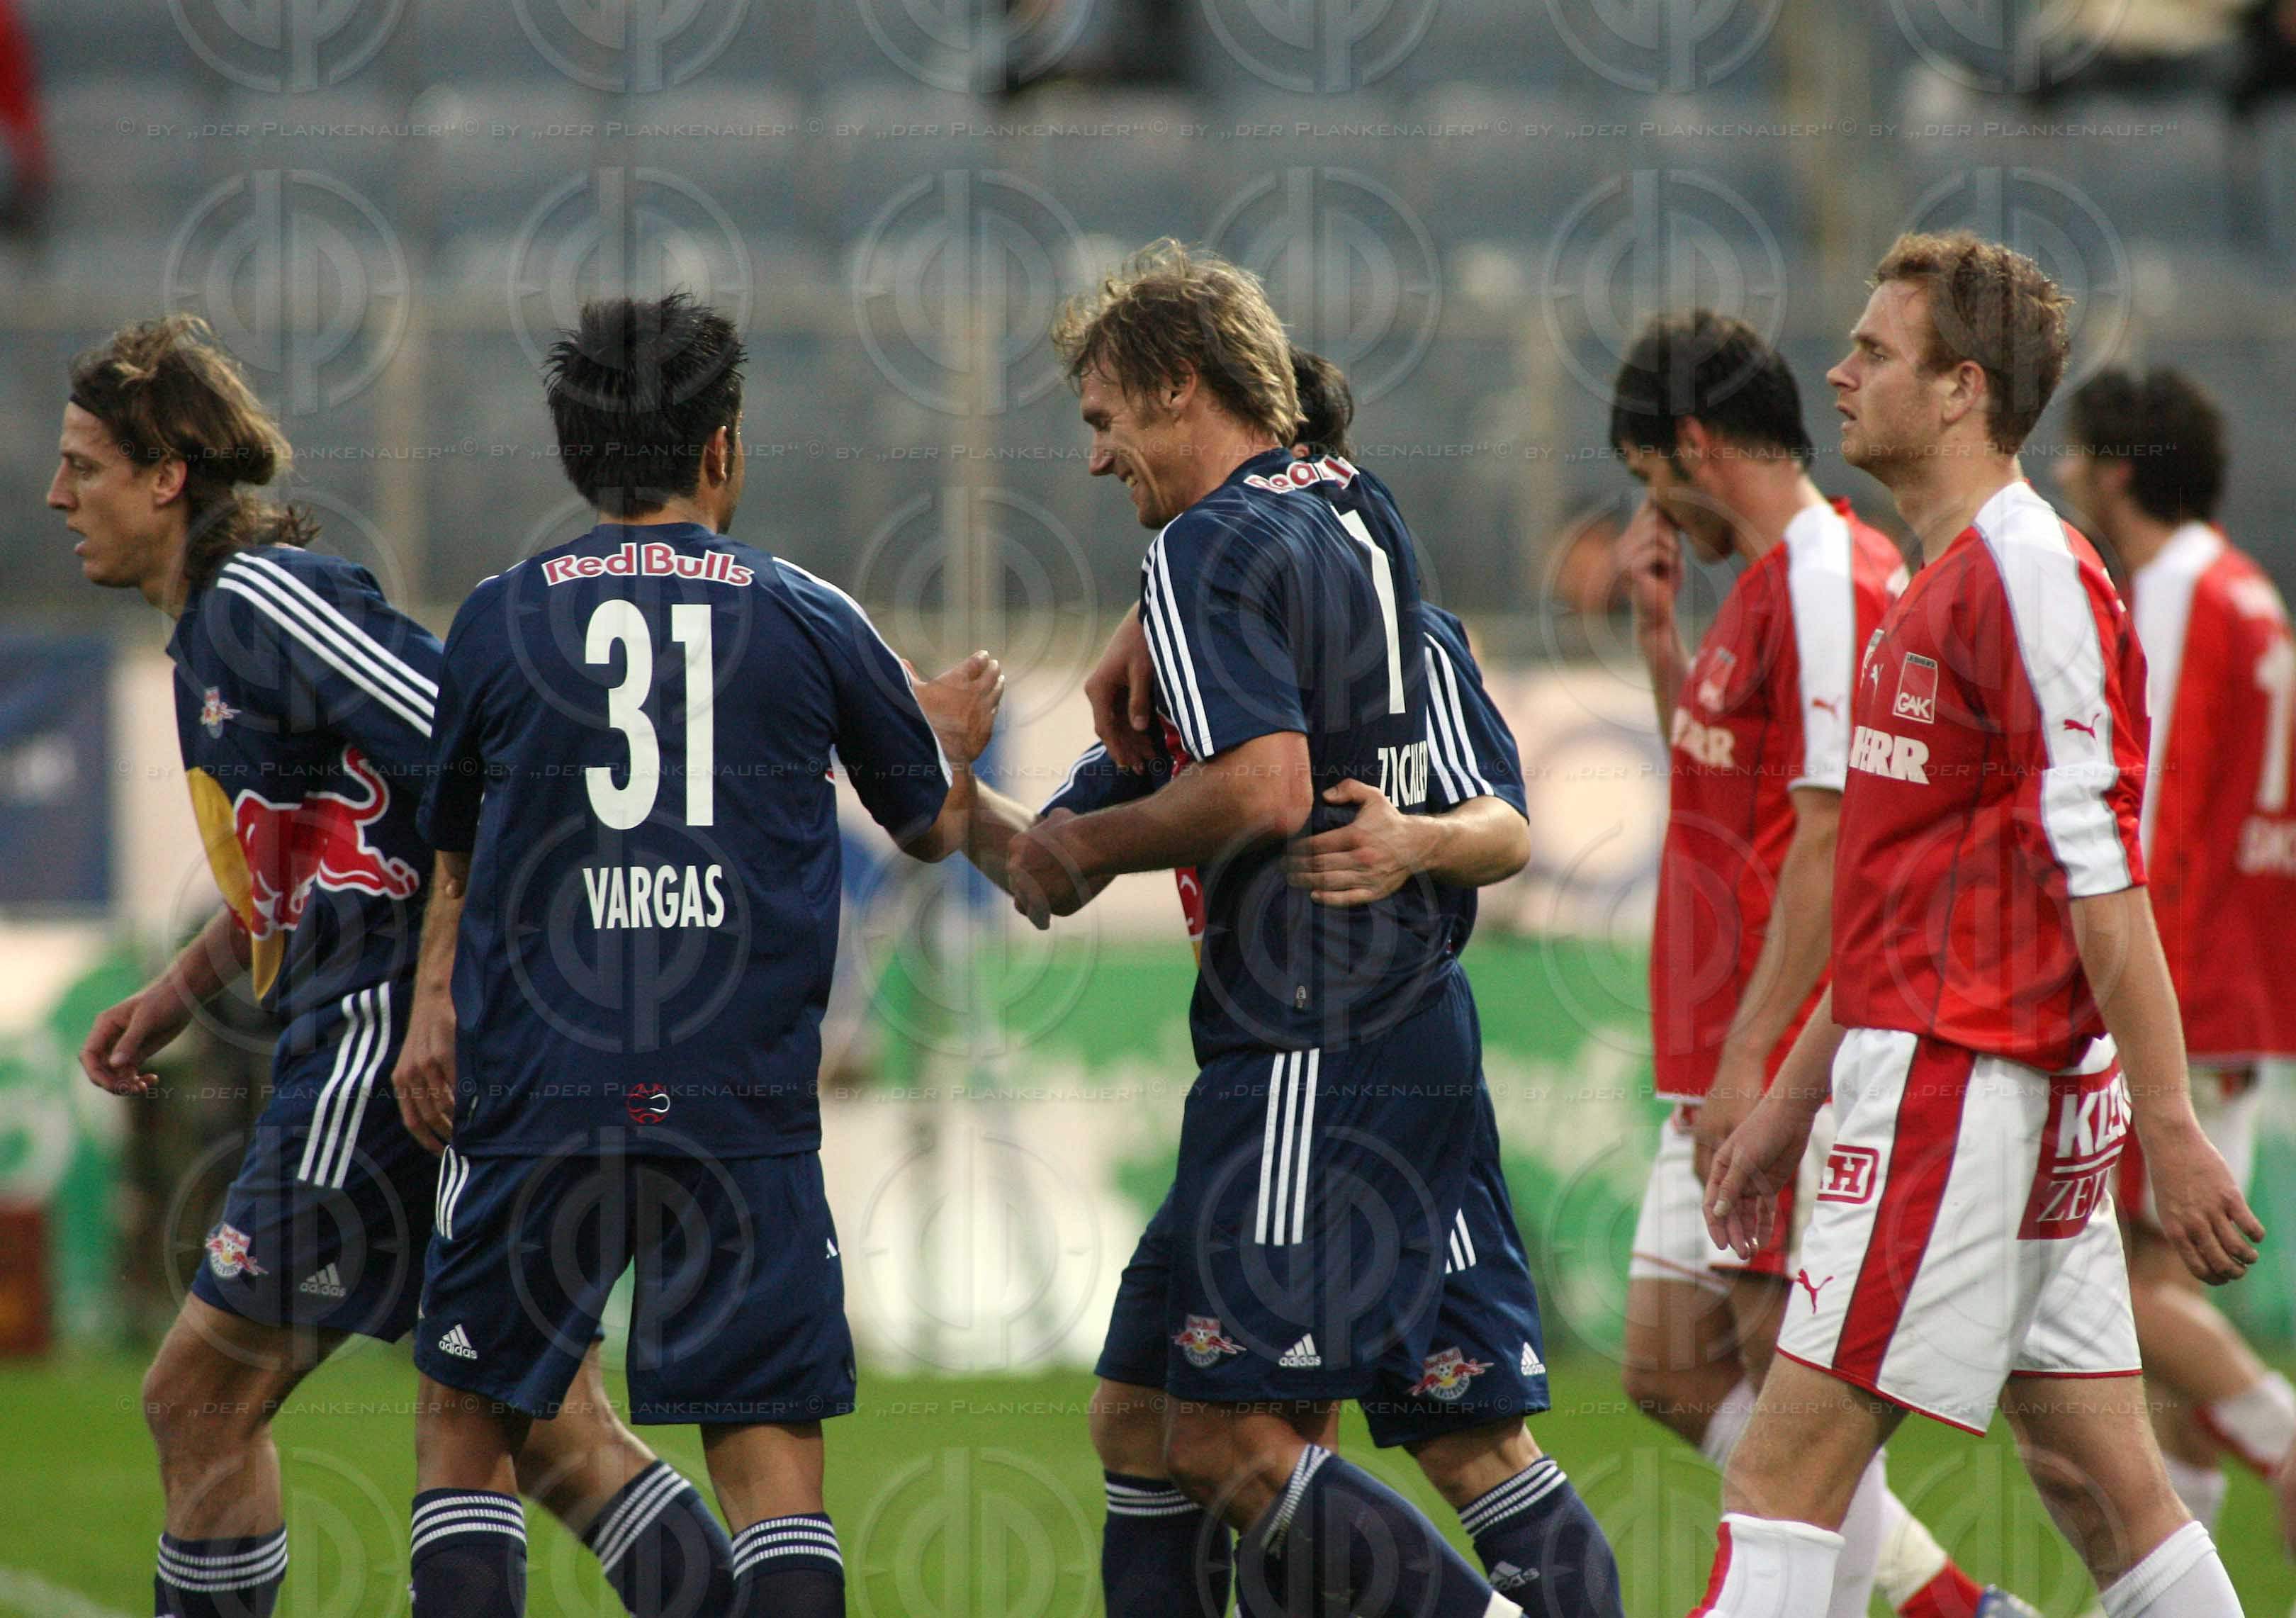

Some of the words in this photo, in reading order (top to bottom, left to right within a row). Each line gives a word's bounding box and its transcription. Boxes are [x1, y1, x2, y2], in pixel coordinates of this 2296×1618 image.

[541, 542, 637, 586] Red
[641, 542, 755, 587] Bulls
[585, 599, 714, 831] 31
[1898, 692, 1932, 718] GAK
[583, 864, 725, 929] VARGAS
[299, 1281, 347, 1298] adidas
[439, 1339, 478, 1359] adidas
[1278, 1356, 1322, 1367] adidas
